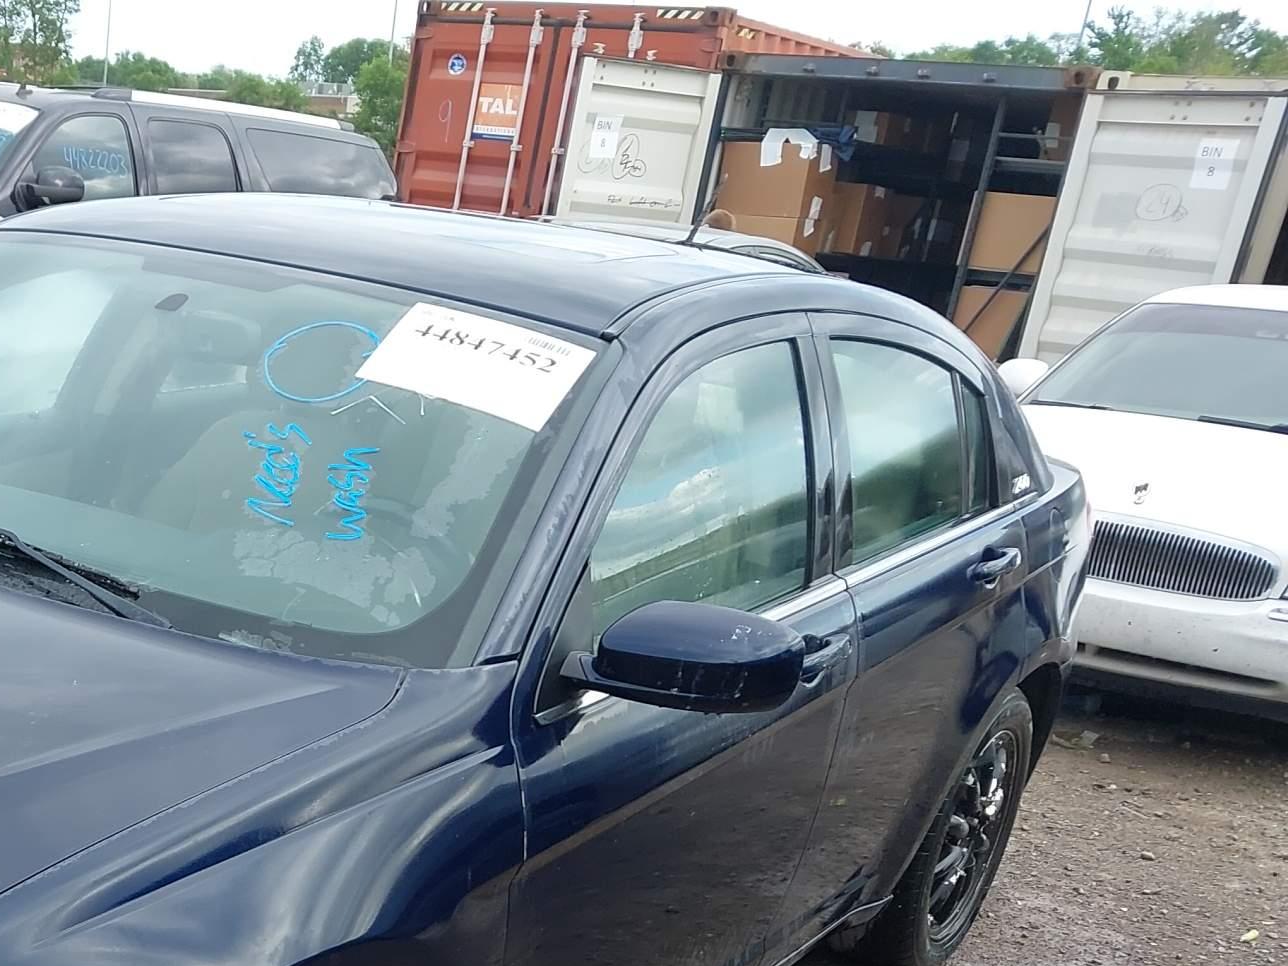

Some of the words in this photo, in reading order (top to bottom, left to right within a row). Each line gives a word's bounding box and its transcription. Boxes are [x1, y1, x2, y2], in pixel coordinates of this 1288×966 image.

[479, 96, 518, 115] TAL
[596, 120, 613, 130] BIN
[1201, 146, 1223, 158] BIN
[1207, 166, 1216, 176] 8
[415, 324, 558, 374] 44847452
